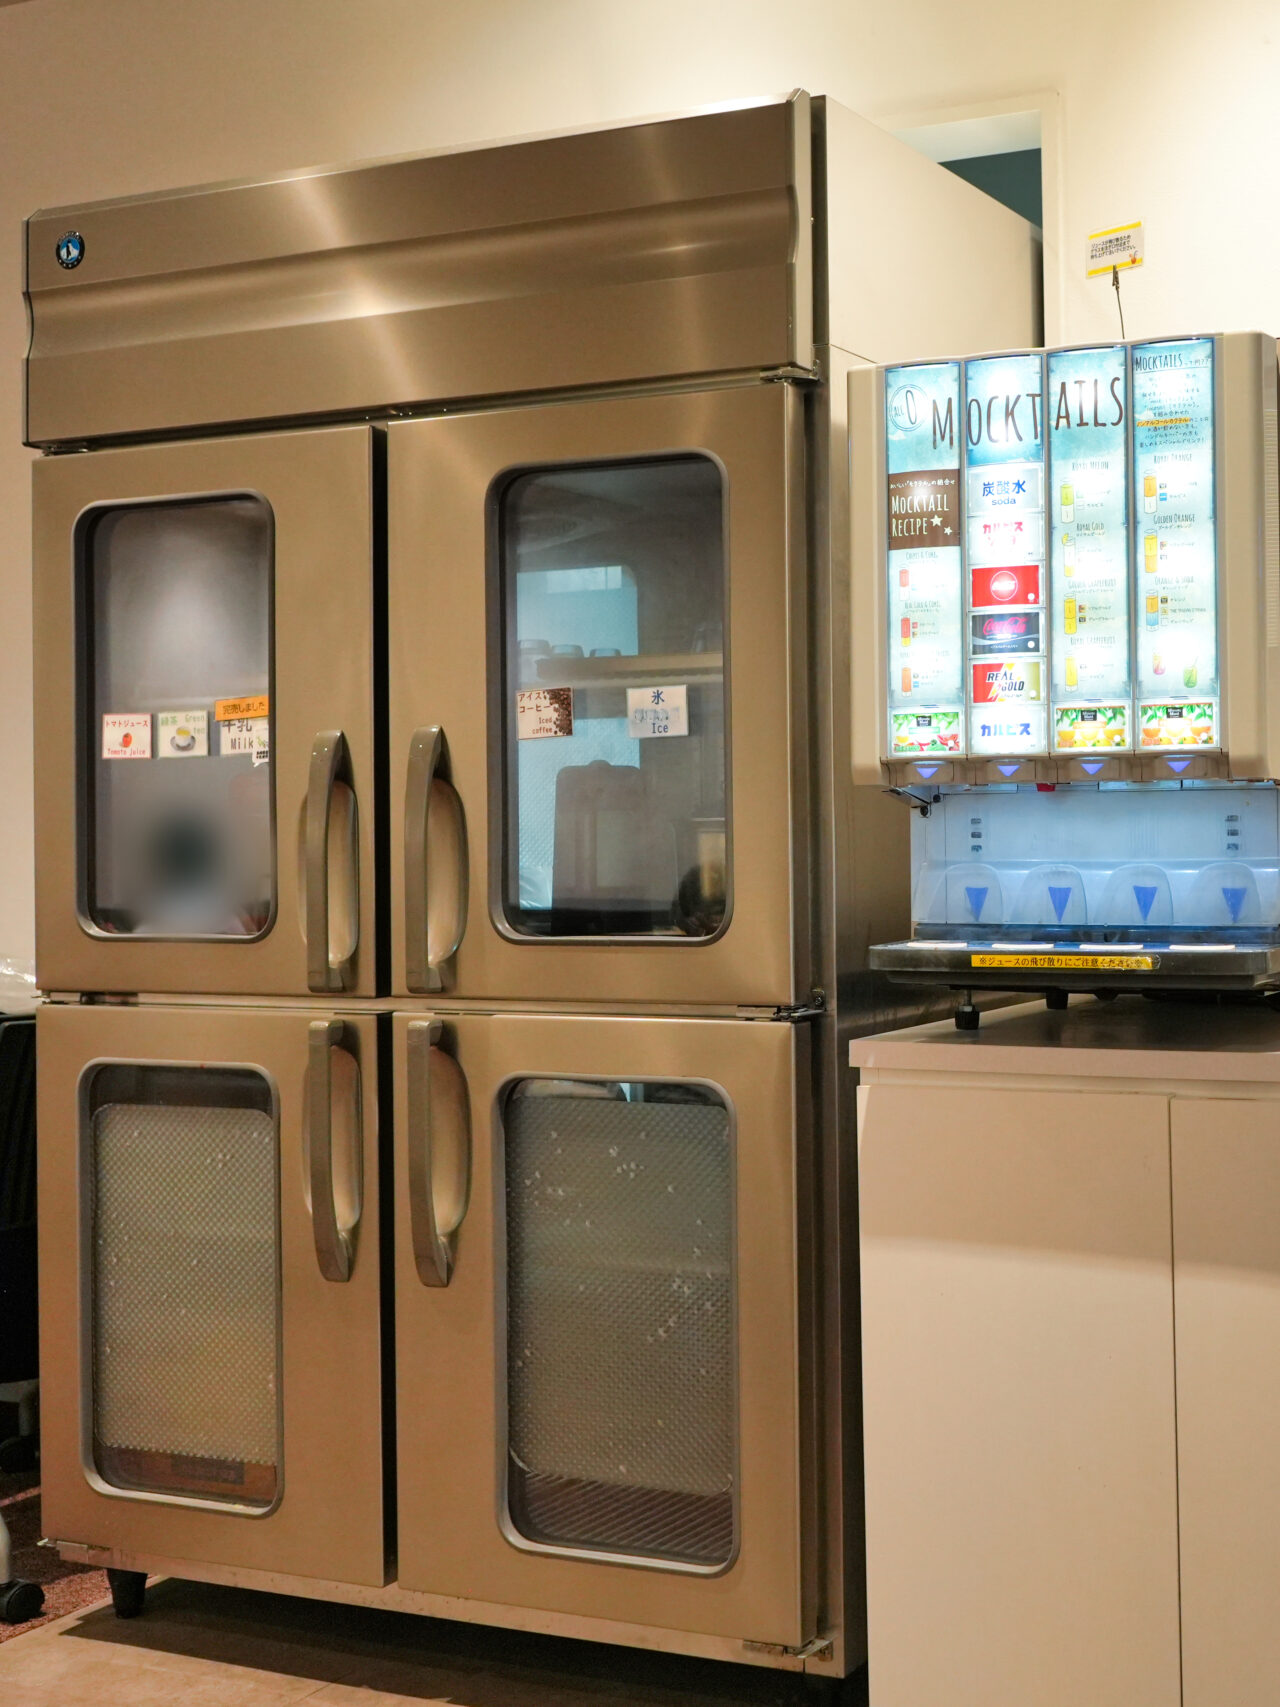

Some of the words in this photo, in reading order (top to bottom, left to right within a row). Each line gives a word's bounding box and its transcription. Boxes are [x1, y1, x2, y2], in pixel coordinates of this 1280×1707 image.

[1135, 353, 1183, 371] MOCKTAILS
[982, 479, 1026, 497] 炭酸水
[891, 494, 950, 515] MOCKTAIL
[991, 497, 1017, 506] soda
[892, 517, 928, 537] RECIPE
[987, 670, 1015, 682] REAL
[1001, 680, 1025, 692] GOLD
[518, 692, 543, 701] アイス
[651, 689, 665, 704] 氷
[222, 702, 265, 715] 完売しました
[519, 703, 552, 713] コーヒー
[105, 719, 149, 728] トマトジュース
[160, 715, 178, 726] 緑茶
[185, 714, 205, 723] Green
[539, 717, 553, 725] Iced
[193, 727, 206, 735] tea
[532, 727, 553, 735] coffee
[651, 722, 669, 734] Ice
[980, 722, 1031, 737] カルピス
[230, 737, 254, 750] Milk
